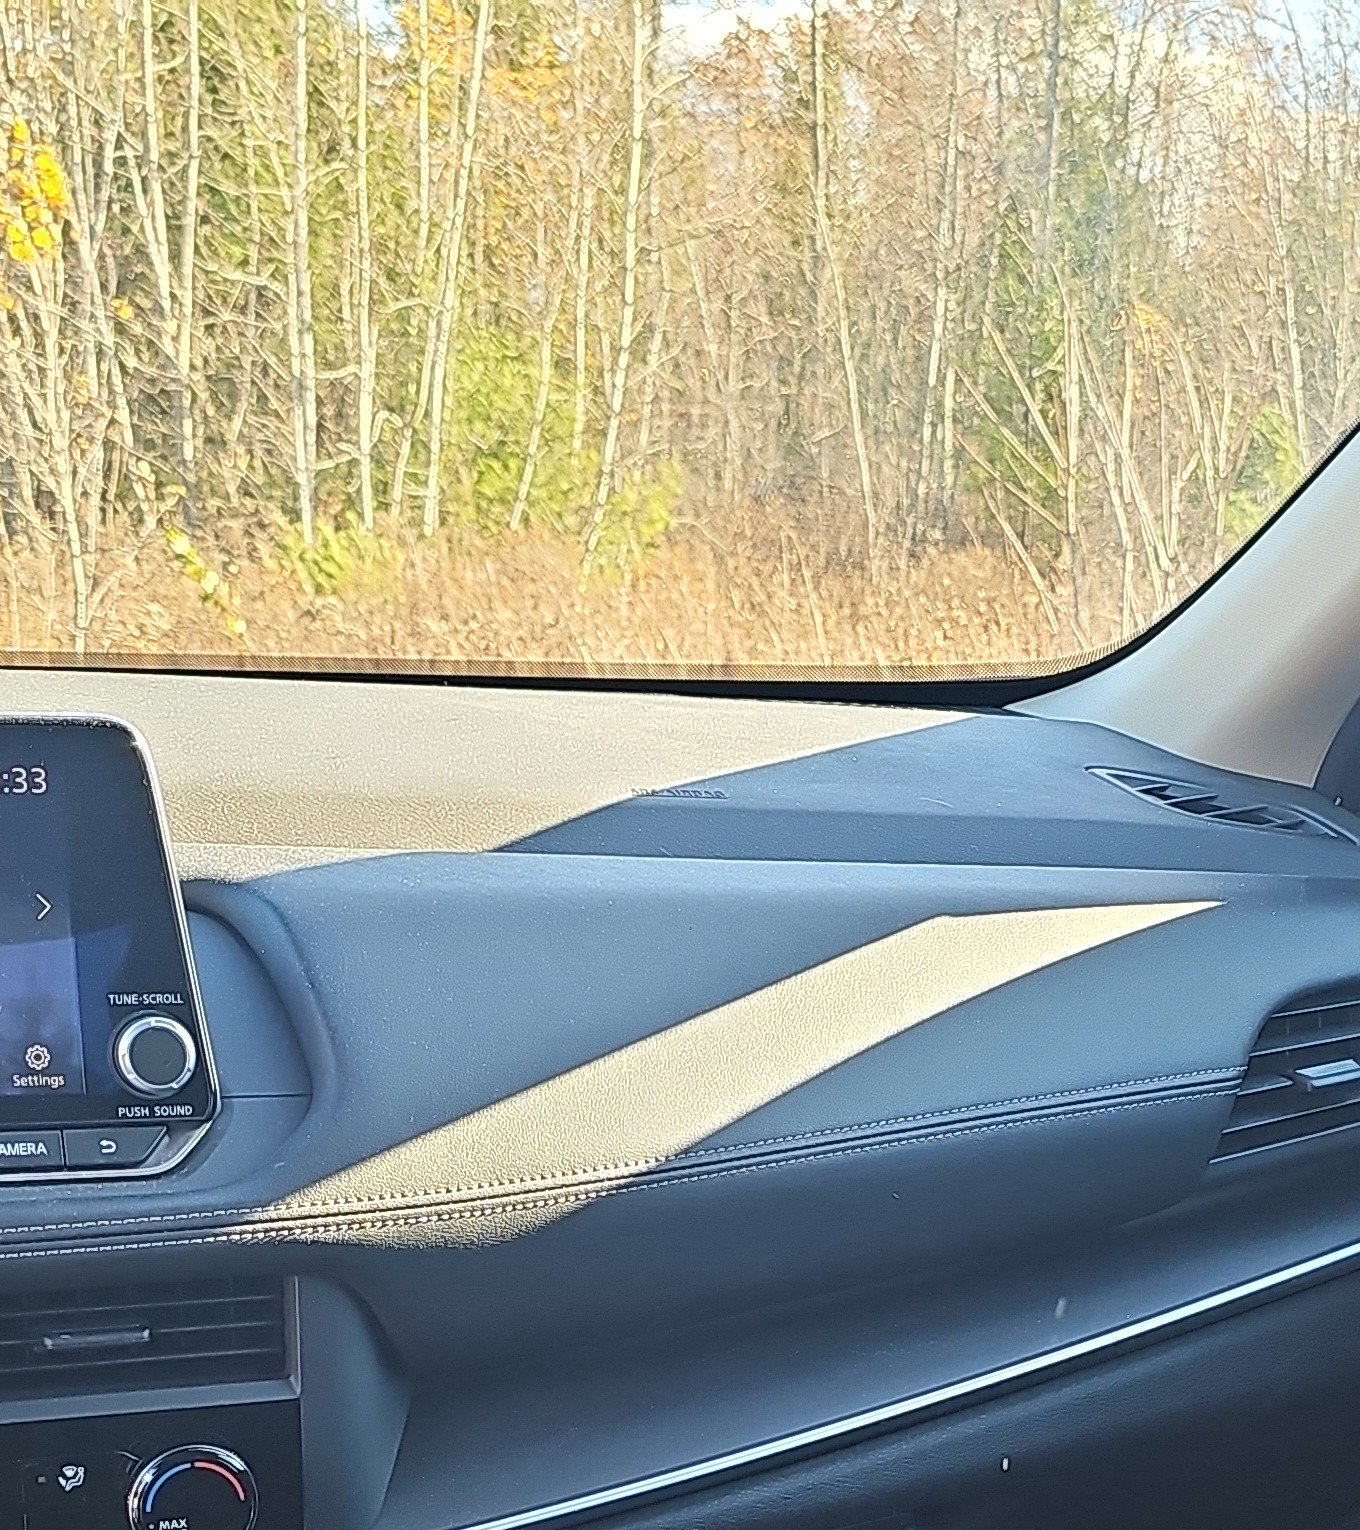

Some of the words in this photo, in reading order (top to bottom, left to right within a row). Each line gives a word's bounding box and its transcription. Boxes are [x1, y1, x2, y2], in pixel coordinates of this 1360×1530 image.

[13, 1073, 64, 1089] Settings
[118, 1105, 149, 1118] PUSH
[154, 1104, 193, 1117] SOUND
